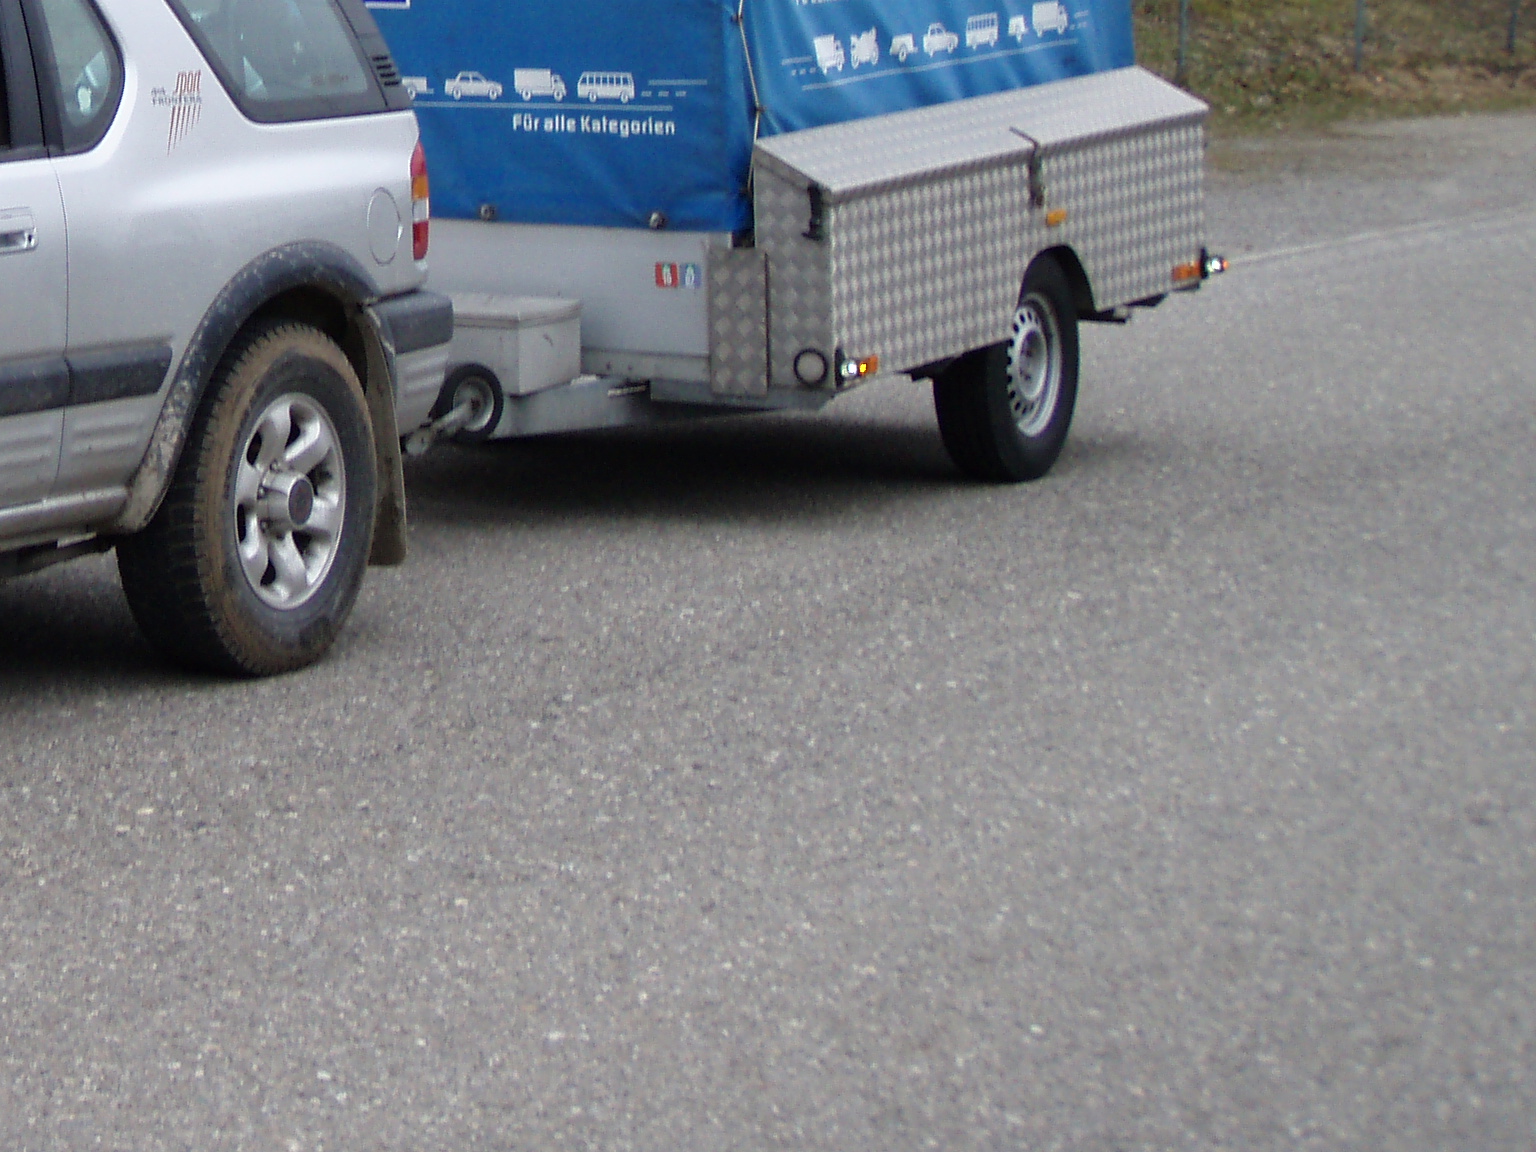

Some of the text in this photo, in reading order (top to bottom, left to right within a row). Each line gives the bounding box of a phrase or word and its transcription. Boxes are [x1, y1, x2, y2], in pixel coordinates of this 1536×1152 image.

[513, 113, 676, 138] Für alle Kategorien
